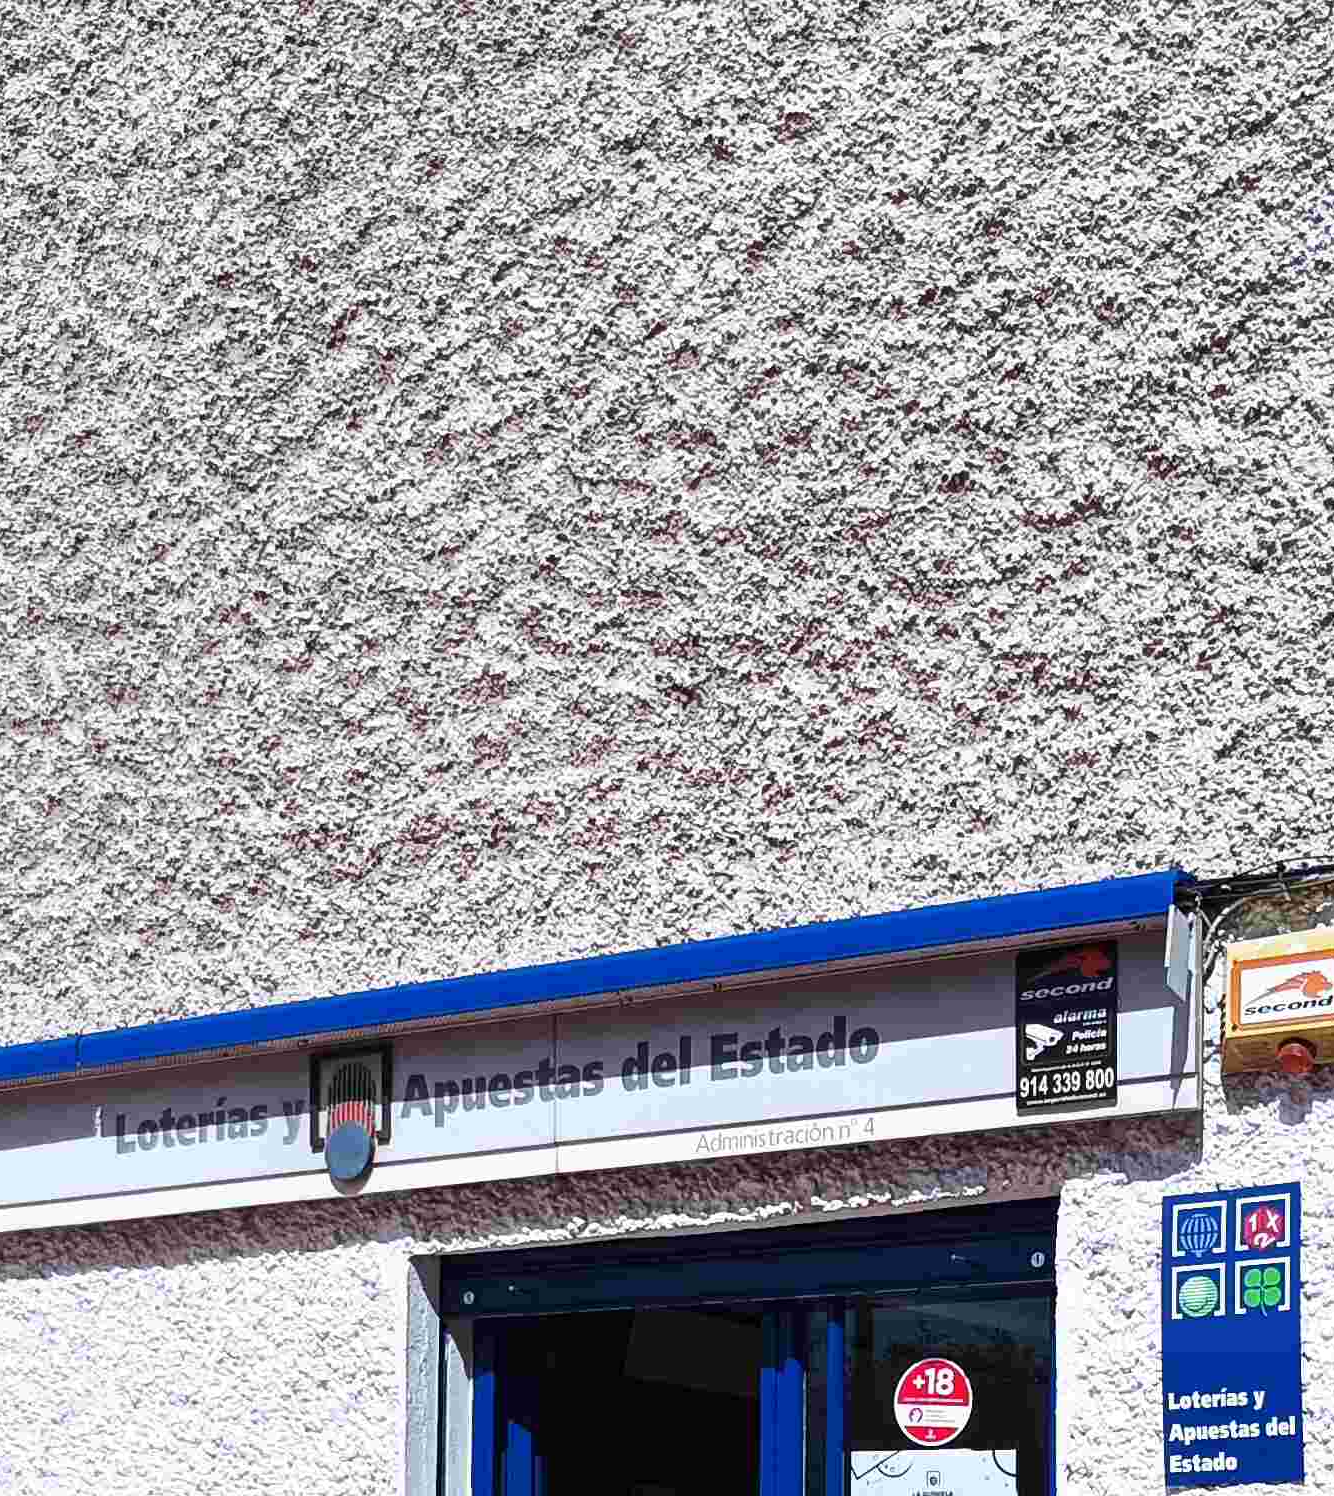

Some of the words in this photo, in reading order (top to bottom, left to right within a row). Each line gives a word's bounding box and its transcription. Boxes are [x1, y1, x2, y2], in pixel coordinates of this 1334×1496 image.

[1020, 977, 1115, 1001] second
[1053, 1008, 1107, 1024] alarma
[1244, 995, 1334, 1015] second
[401, 1054, 606, 1128] Apuestas
[621, 1034, 693, 1093] del
[709, 1016, 881, 1082] Estado
[1020, 1073, 1049, 1098] 914
[1052, 1070, 1081, 1094] 339
[1085, 1066, 1115, 1091] 800
[115, 1096, 268, 1155] Loterías
[282, 1099, 309, 1147] y
[695, 1122, 834, 1153] Administración
[862, 1116, 876, 1137] 4
[912, 1367, 956, 1396] +18
[1168, 1387, 1249, 1411] Loterías
[1253, 1389, 1267, 1411] y
[1168, 1419, 1261, 1446] Apuestas
[1266, 1415, 1297, 1436] del
[1169, 1451, 1238, 1474] Estado
